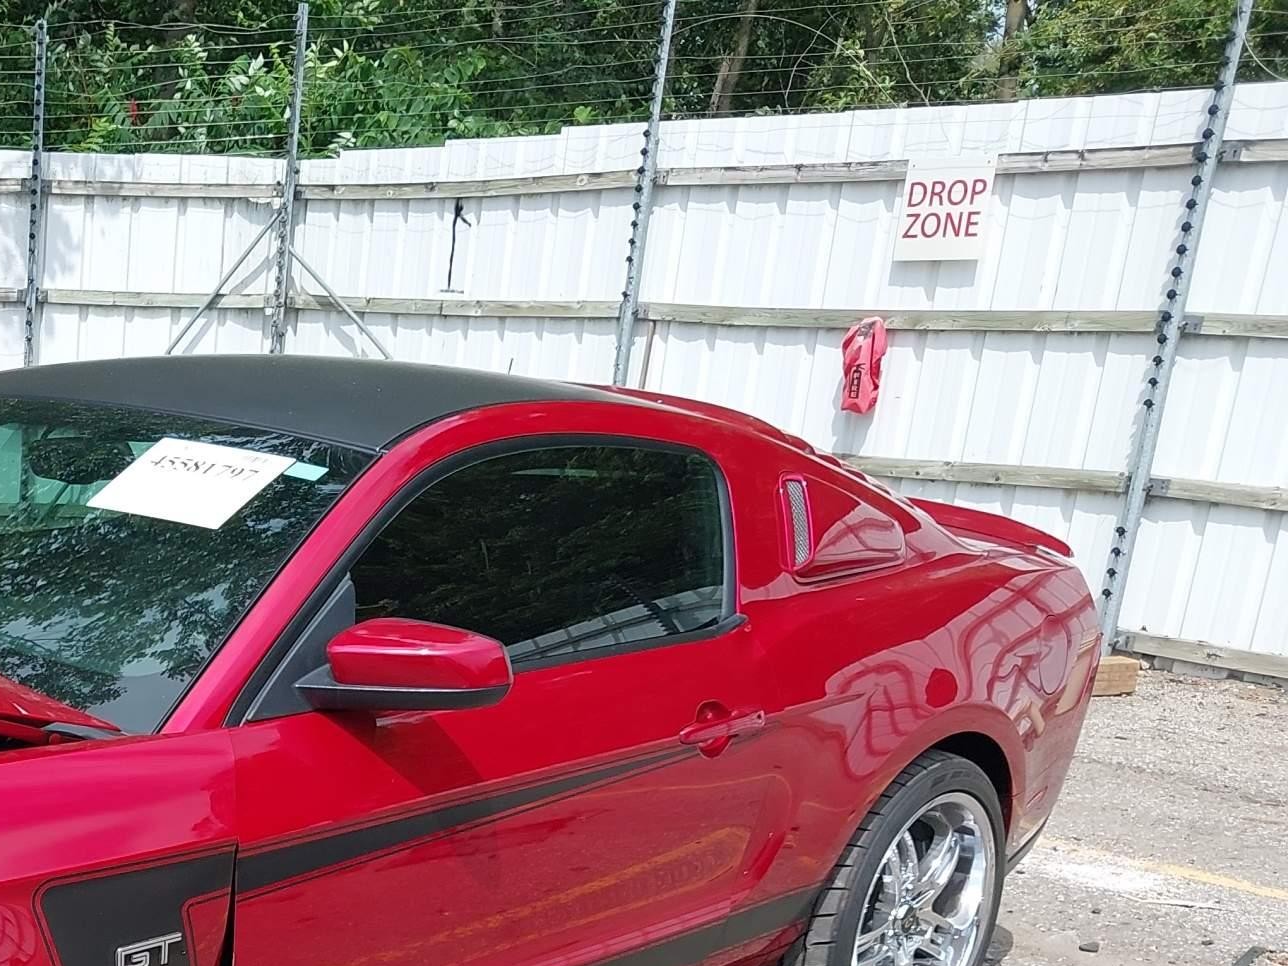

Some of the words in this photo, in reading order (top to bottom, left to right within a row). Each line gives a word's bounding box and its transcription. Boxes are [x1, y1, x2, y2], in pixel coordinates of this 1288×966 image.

[907, 178, 988, 208] DROP
[902, 211, 982, 239] ZONE
[150, 455, 260, 480] 45581797
